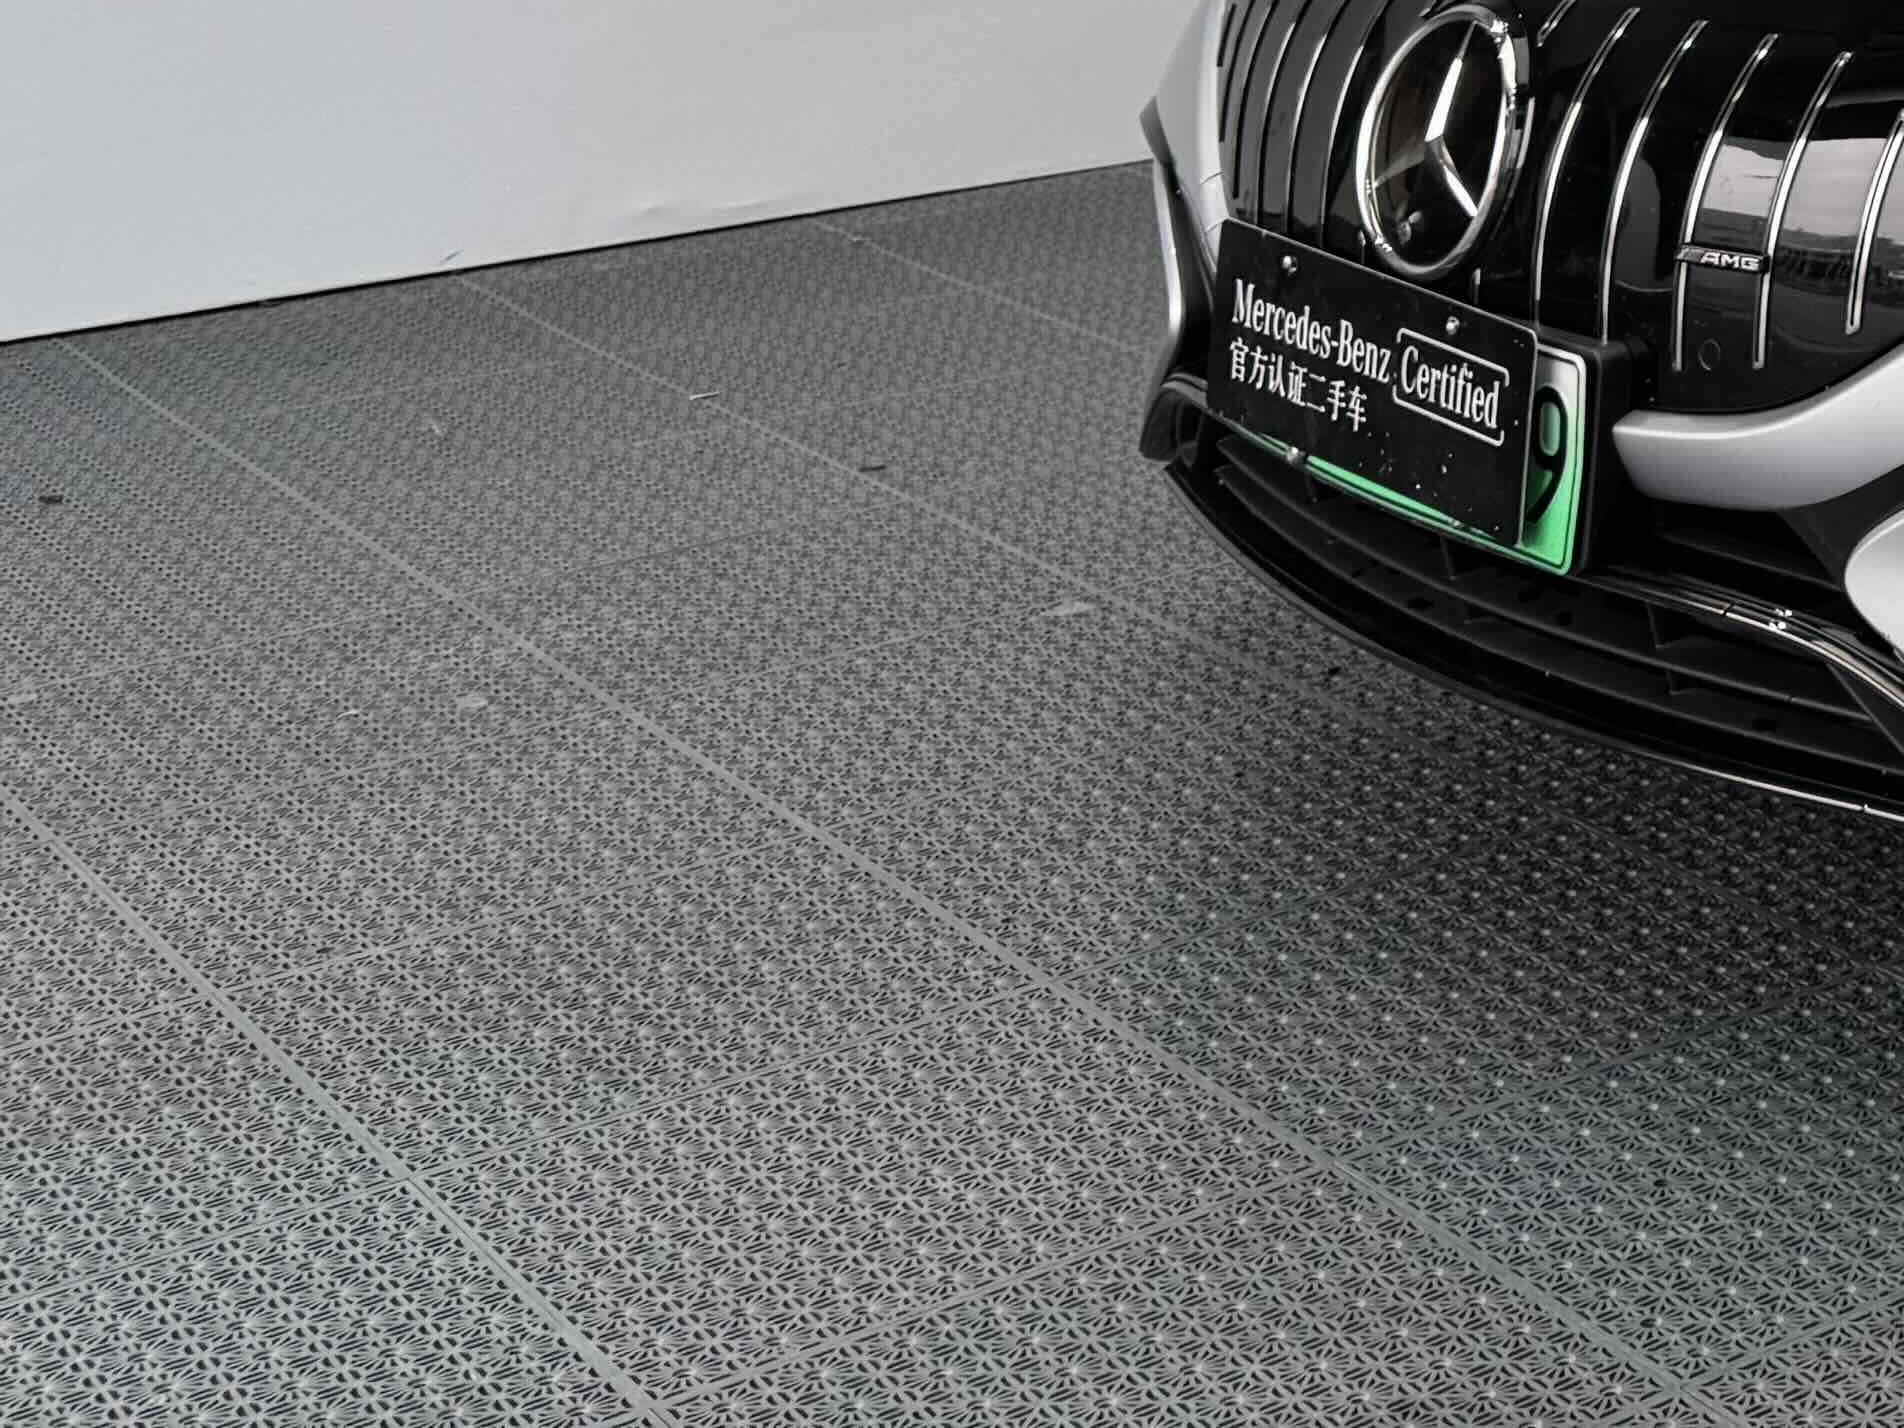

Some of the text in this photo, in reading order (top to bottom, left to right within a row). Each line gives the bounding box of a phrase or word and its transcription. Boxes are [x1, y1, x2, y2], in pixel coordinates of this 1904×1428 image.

[1700, 251, 1761, 272] AMG
[1229, 337, 1368, 432] 官方认证二手车
[1231, 278, 1501, 429] Mercedes-Benz Certified
